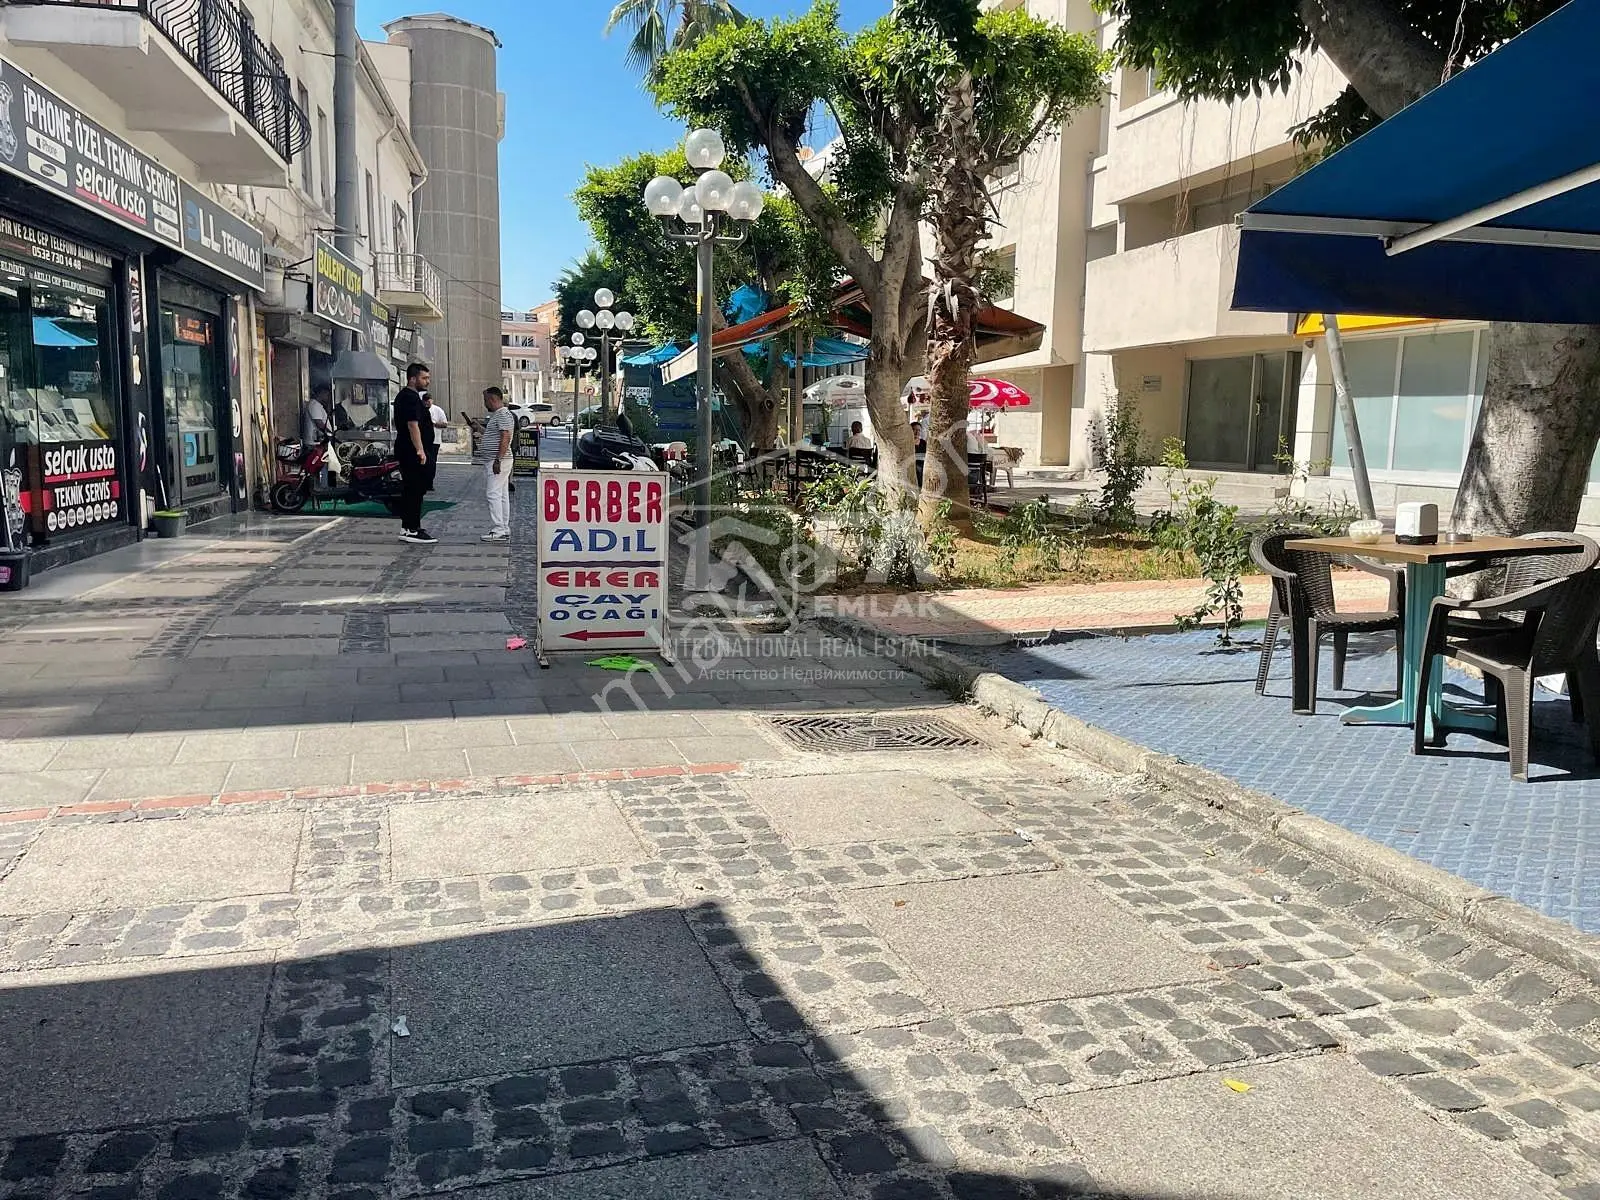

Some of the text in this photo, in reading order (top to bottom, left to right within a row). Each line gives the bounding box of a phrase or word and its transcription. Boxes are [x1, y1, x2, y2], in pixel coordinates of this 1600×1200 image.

[74, 111, 106, 168] ÖZEL
[104, 136, 144, 190] TEKNİK
[144, 164, 178, 207] SERVİS
[75, 162, 119, 206] selçuk
[120, 184, 147, 219] usta
[44, 444, 115, 480] selçuk usta
[54, 478, 111, 509] TEKNİK SERVİS
[544, 479, 662, 524] BERBER
[546, 571, 659, 588] EKER
[549, 606, 658, 621] OCAĞI
[554, 593, 651, 608] ÇAY
